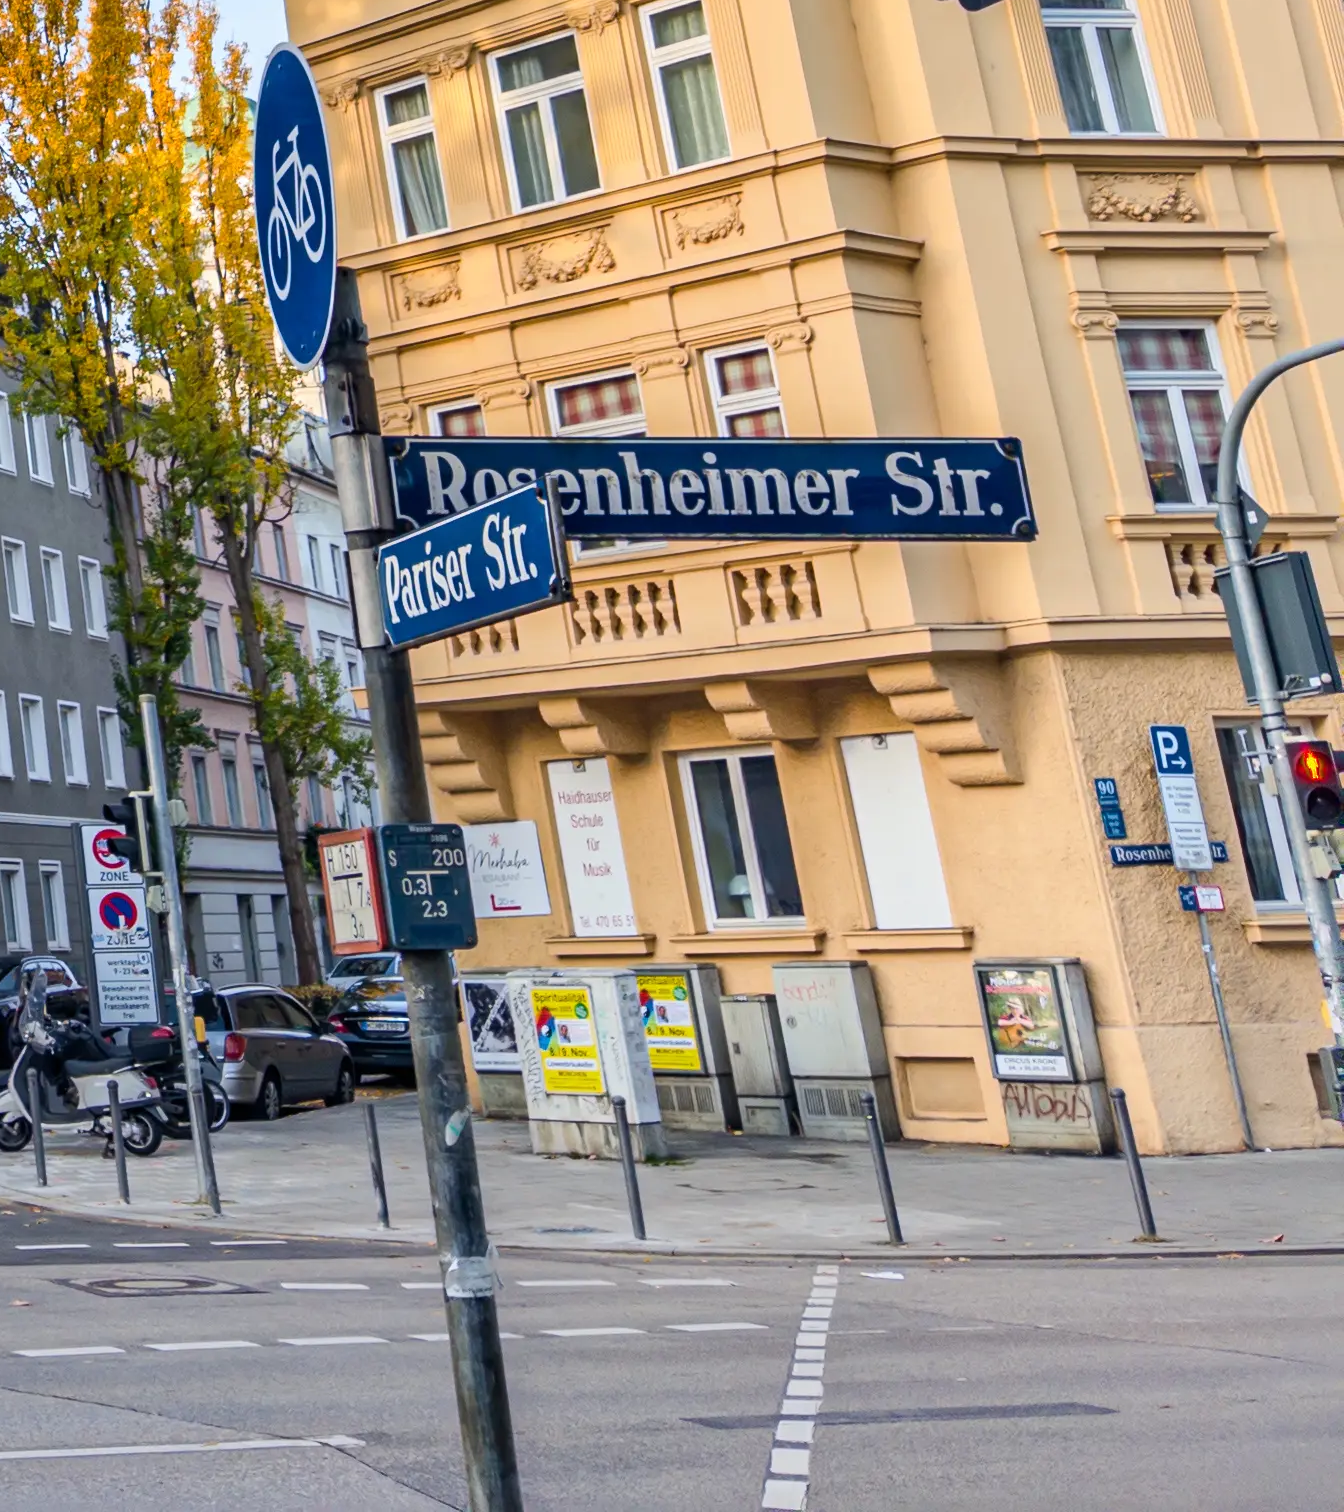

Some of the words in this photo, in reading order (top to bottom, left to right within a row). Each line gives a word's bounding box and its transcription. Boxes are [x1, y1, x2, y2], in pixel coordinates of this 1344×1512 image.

[886, 452, 1005, 518] Str.
[384, 540, 476, 625] Pariser
[482, 511, 539, 592] Str.
[1097, 780, 1115, 795] 90
[558, 791, 612, 805] Haidhauser
[570, 814, 604, 829] Schule
[586, 838, 601, 852] für
[326, 848, 336, 873] H
[338, 843, 359, 871] 150
[388, 850, 398, 867] S
[432, 848, 465, 867] 200
[467, 844, 530, 874] Merhaba
[100, 871, 130, 882] ZONE
[582, 862, 613, 878] Musik
[401, 877, 427, 896] 0.3
[421, 899, 449, 918] 2.3
[595, 915, 610, 928] 470
[612, 915, 623, 928] 65
